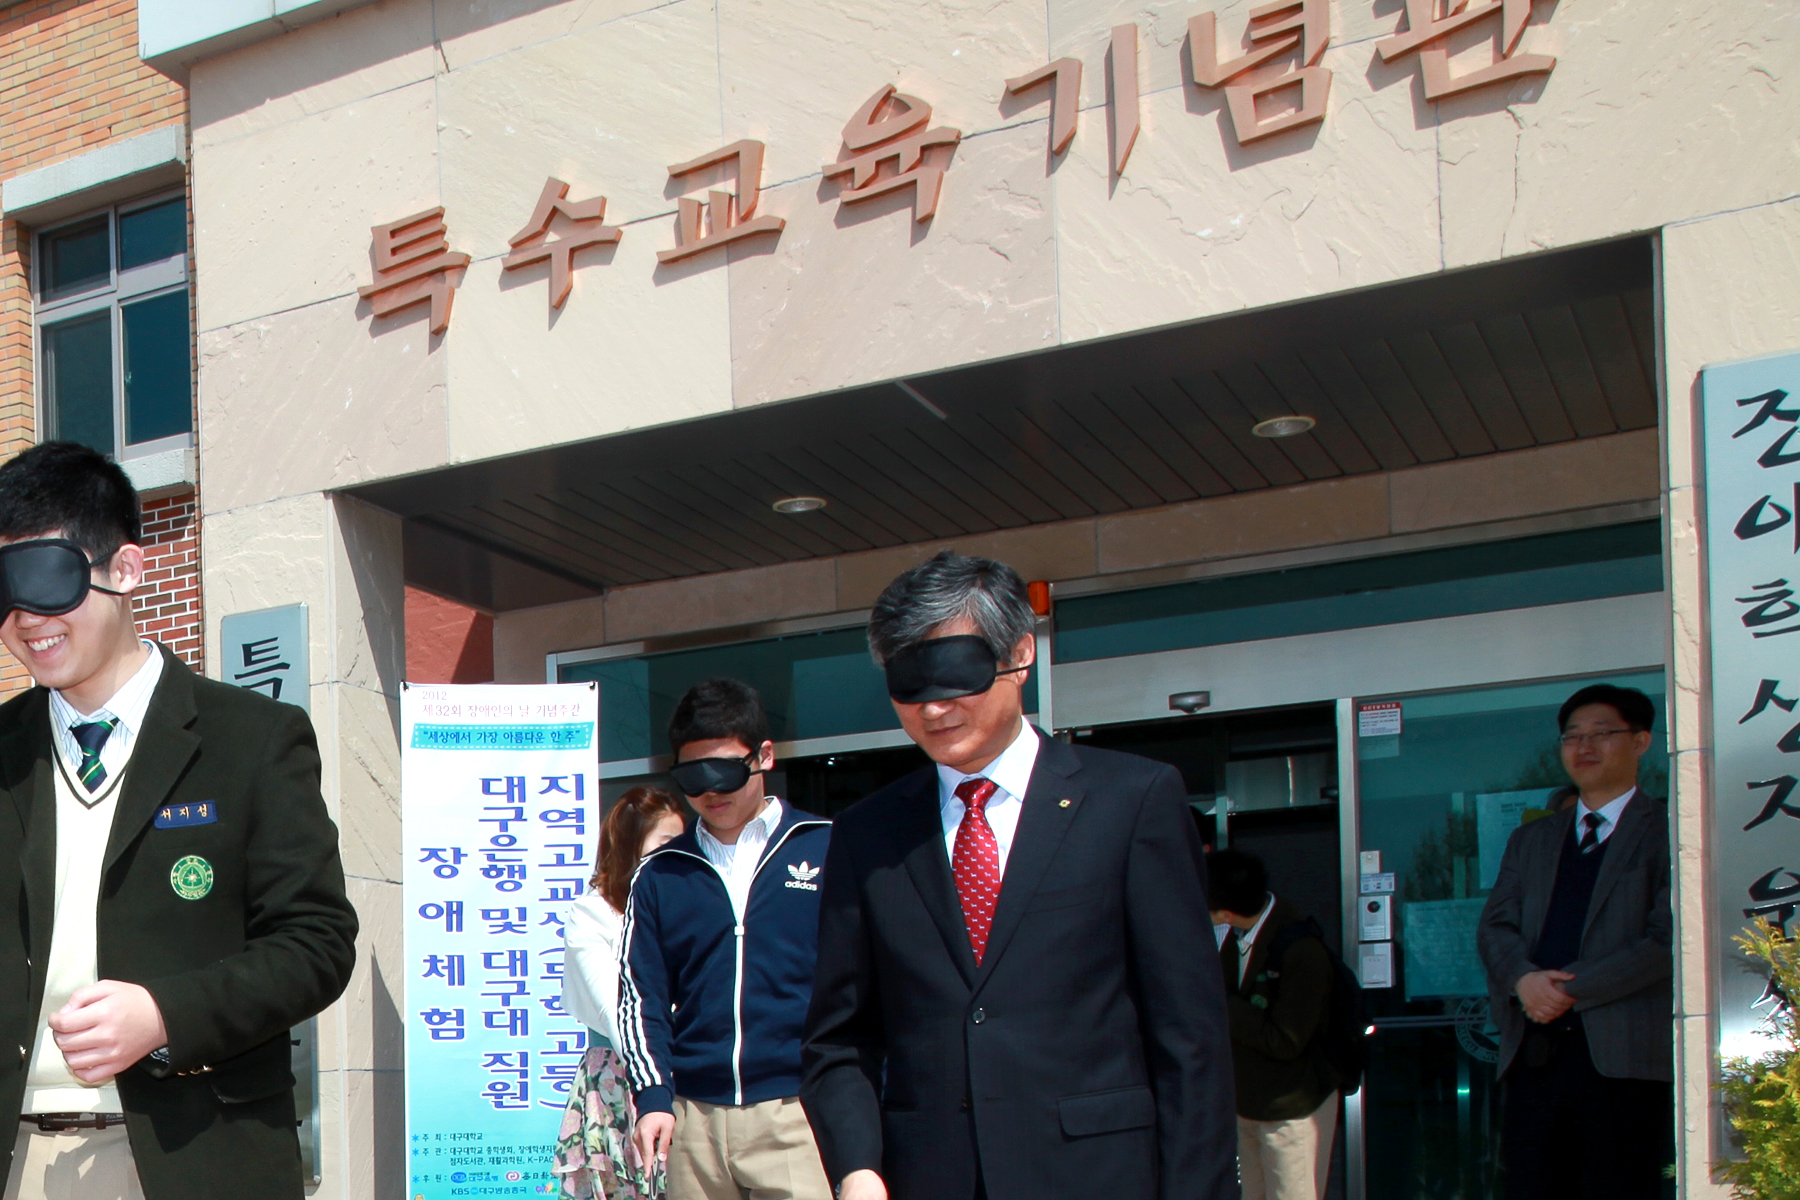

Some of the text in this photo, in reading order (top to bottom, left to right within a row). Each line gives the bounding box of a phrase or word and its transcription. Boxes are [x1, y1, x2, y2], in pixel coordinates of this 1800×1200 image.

[422, 690, 447, 701] 2012
[422, 703, 581, 718] 제32회 장애인의 날 기념주간
[477, 730, 498, 744] 가장
[503, 730, 546, 744] 아름다운
[550, 730, 561, 744] 한
[785, 880, 817, 891] adidas
[478, 775, 531, 1109] 대구은행 및 대구대 직원
[449, 1132, 483, 1142] 대구대학교
[449, 1146, 483, 1156] 대구대학교
[451, 1187, 470, 1195] KBS
